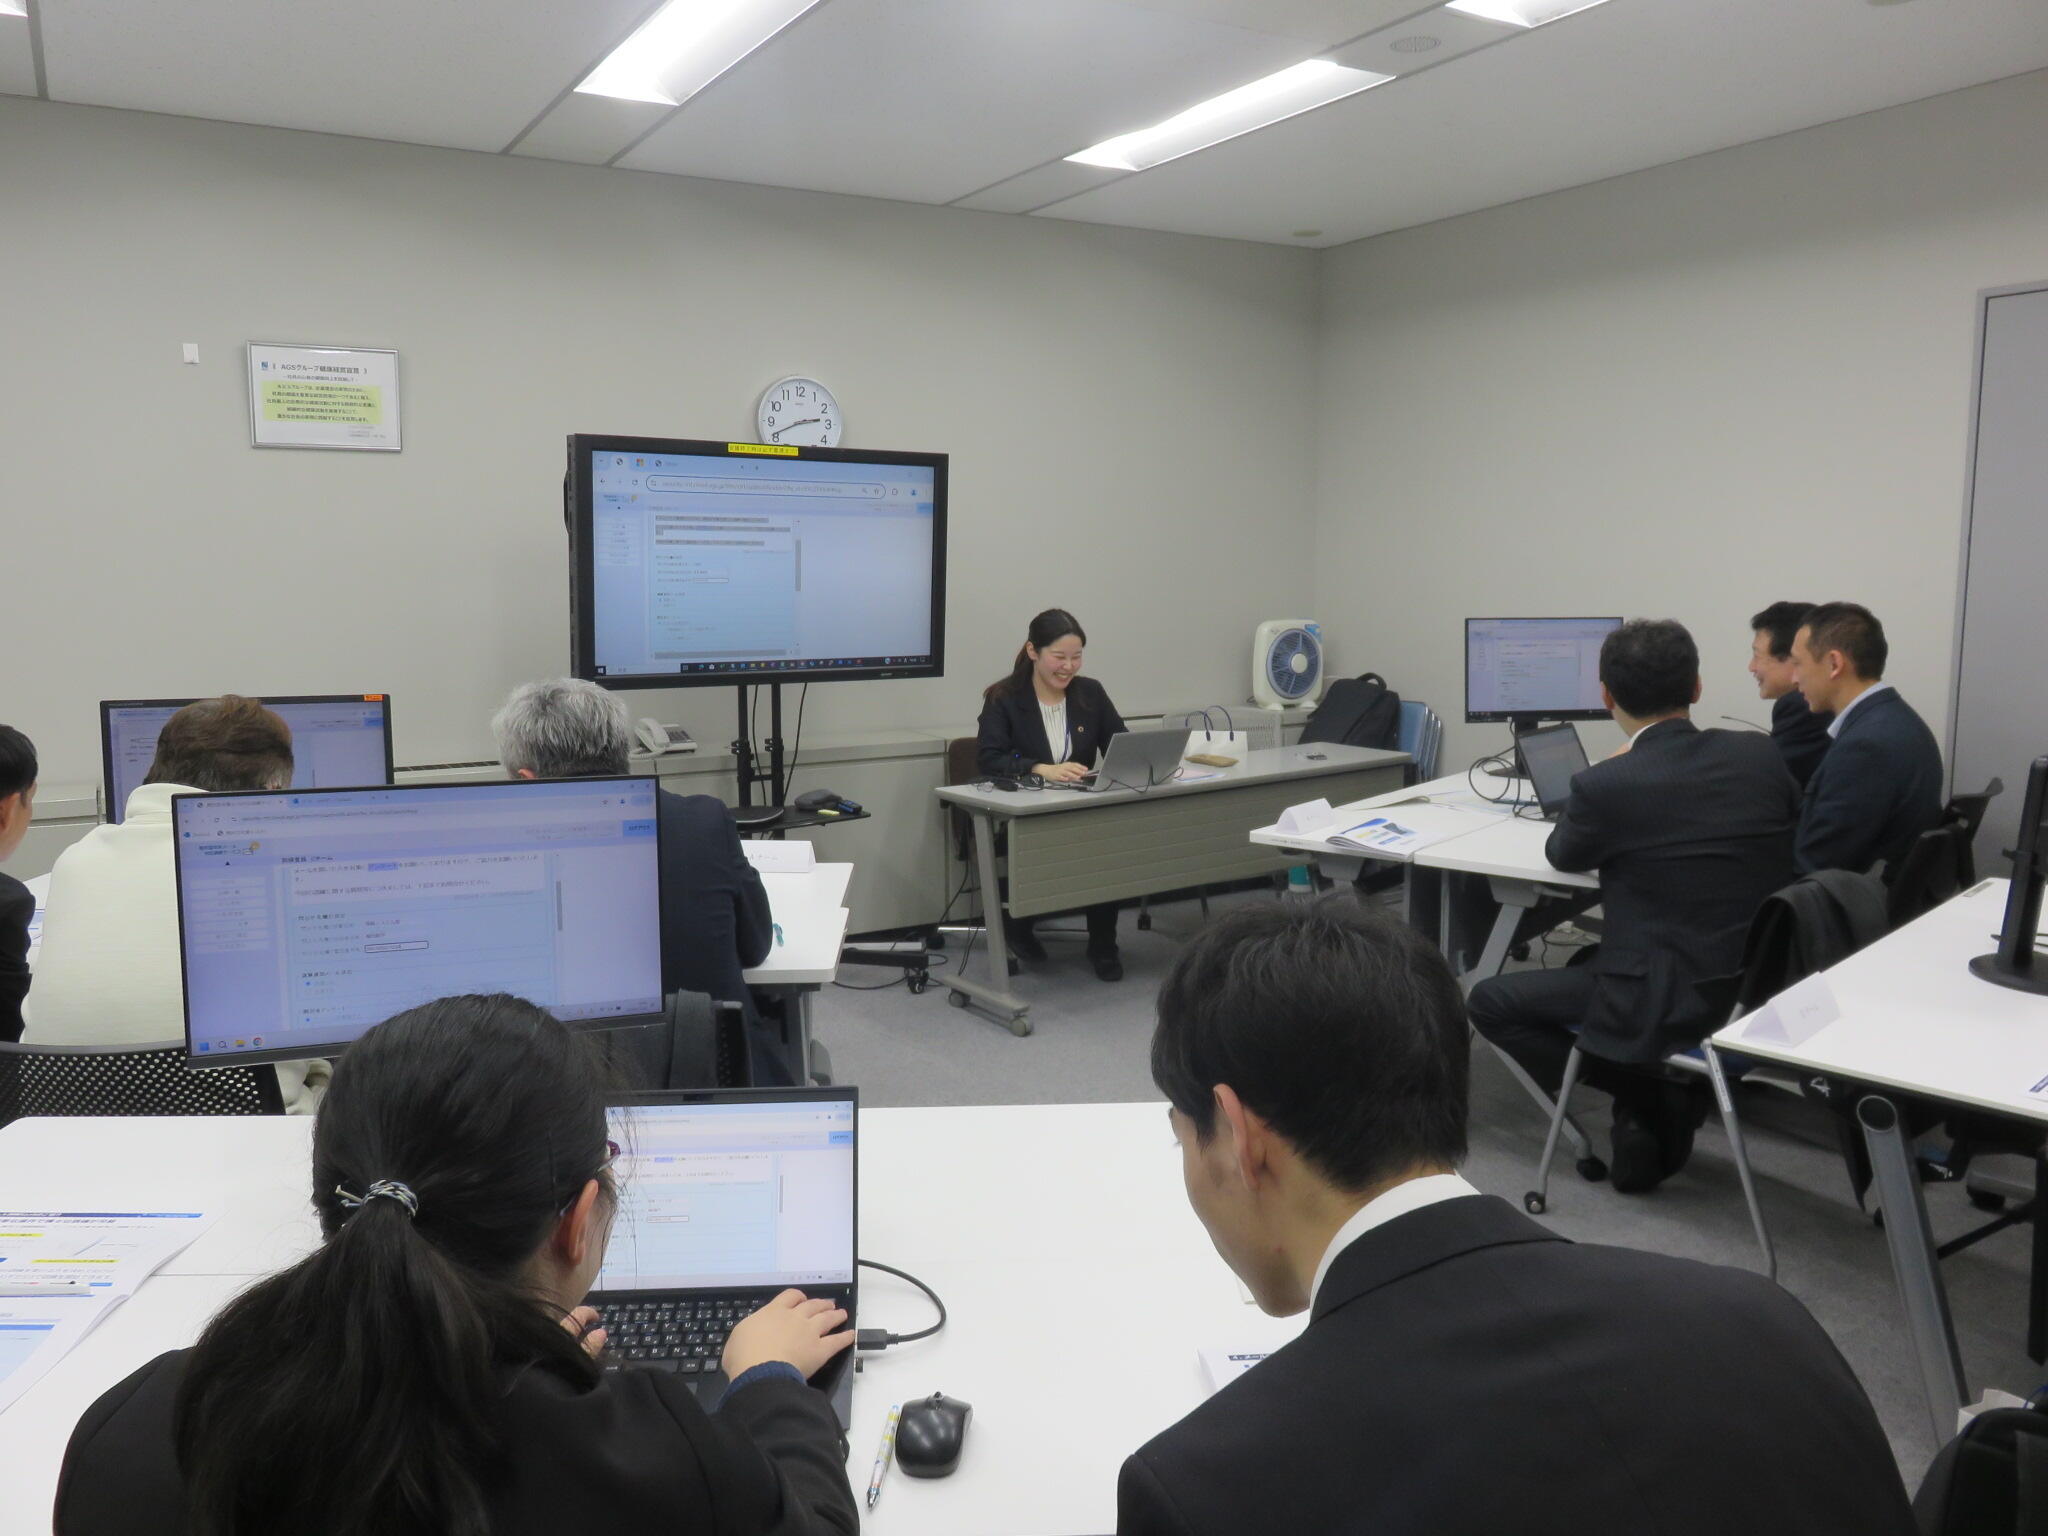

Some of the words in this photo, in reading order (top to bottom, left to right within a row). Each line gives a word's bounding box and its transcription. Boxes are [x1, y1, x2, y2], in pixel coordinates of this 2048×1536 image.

[783, 390, 789, 400] 11
[796, 386, 805, 397] 12
[813, 392, 816, 402] 1
[771, 401, 781, 412] 10
[821, 403, 827, 414] 2
[768, 416, 775, 427] 9
[825, 419, 832, 430] 3
[772, 432, 779, 443] 8
[820, 435, 827, 445] 4
